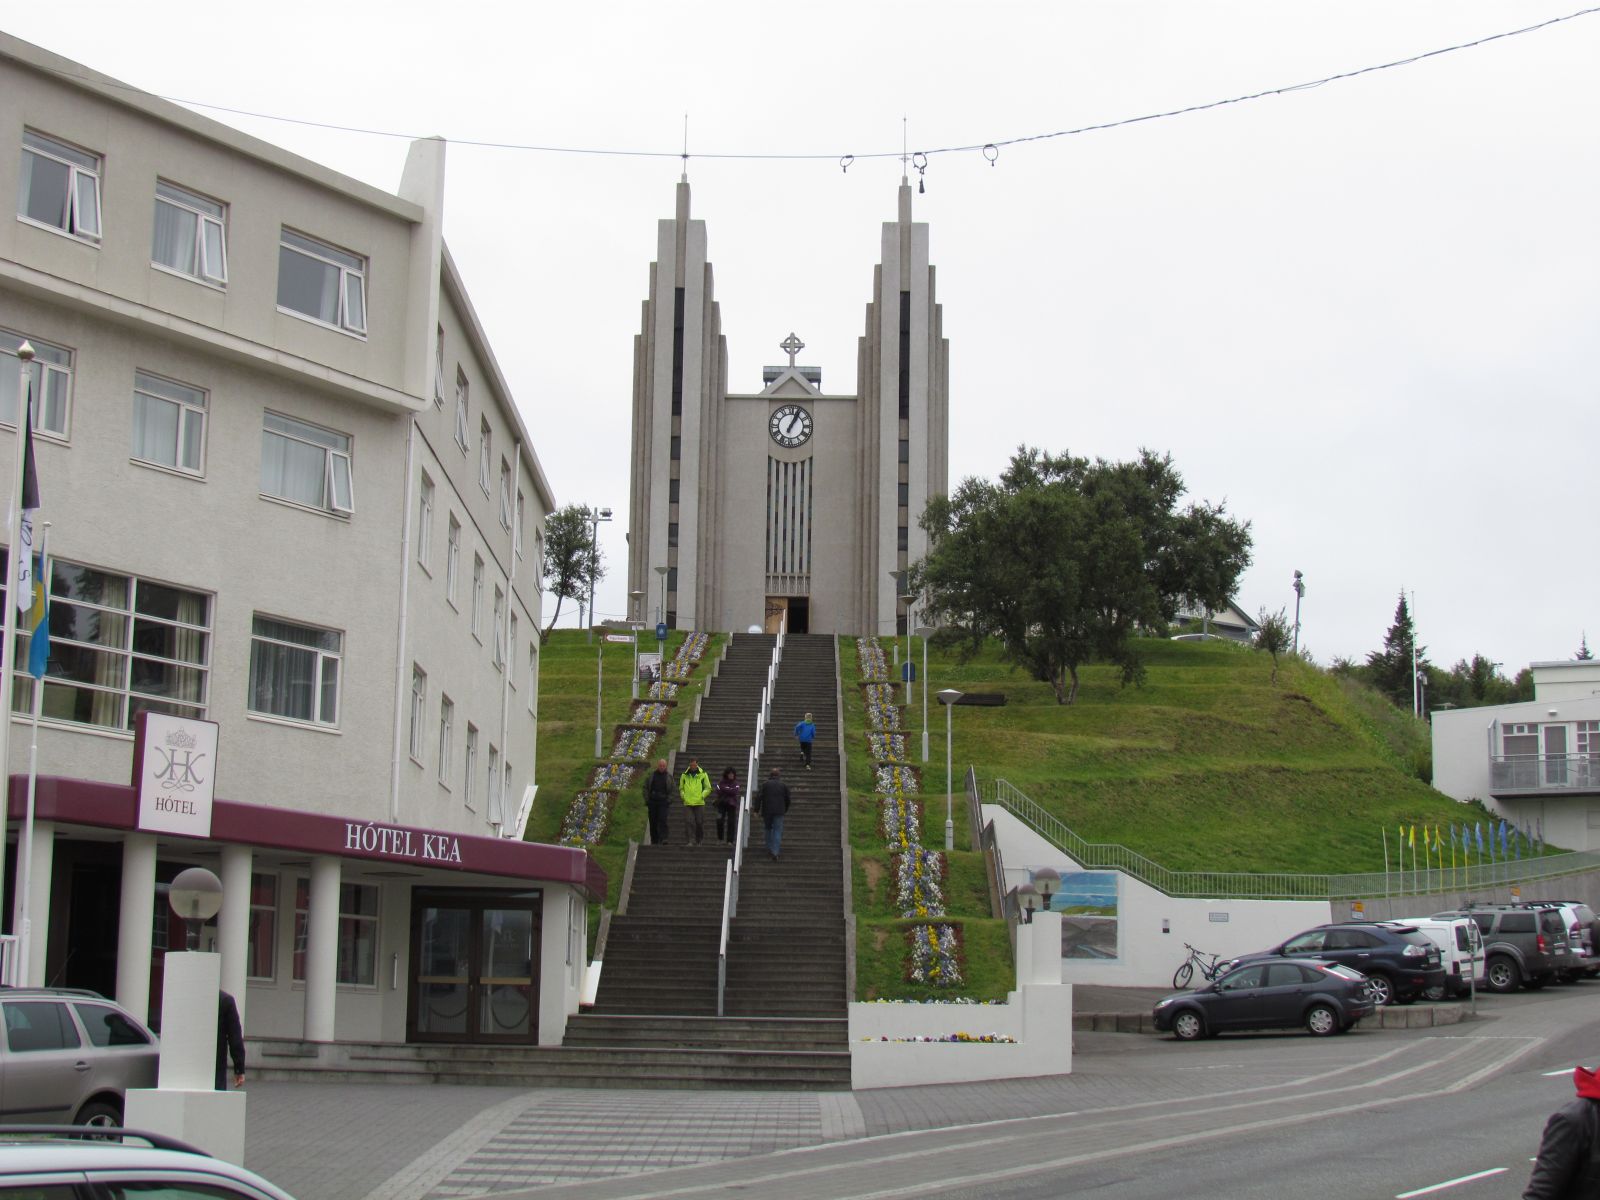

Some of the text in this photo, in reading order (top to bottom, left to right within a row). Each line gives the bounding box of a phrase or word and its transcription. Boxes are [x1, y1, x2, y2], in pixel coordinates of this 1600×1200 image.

[155, 795, 197, 815] HÓTEL
[344, 821, 462, 862] HÓTEL KEA
